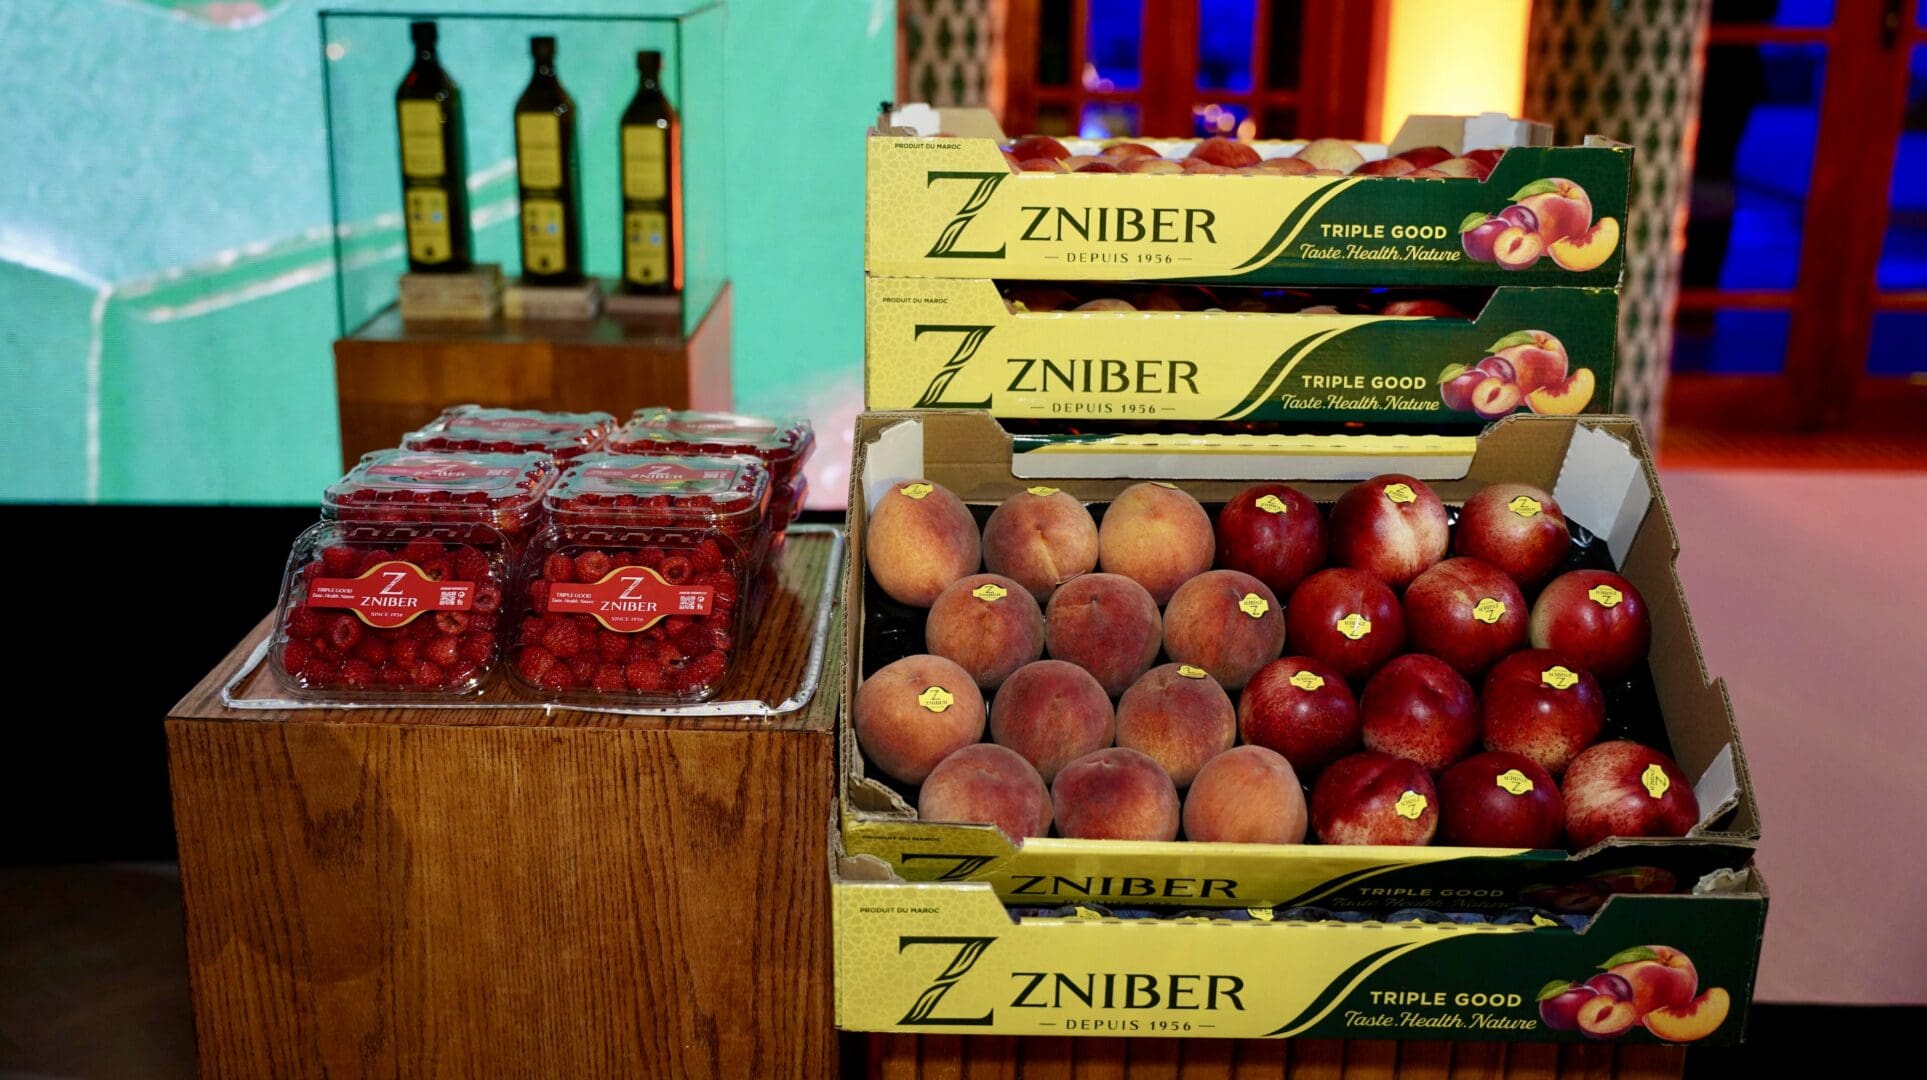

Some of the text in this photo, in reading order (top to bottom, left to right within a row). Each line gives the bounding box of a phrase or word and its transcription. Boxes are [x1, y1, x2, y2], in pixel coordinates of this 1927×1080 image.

[924, 171, 1010, 259] Z
[1019, 206, 1218, 244] ZNIBER
[1321, 224, 1448, 239] TRIPLE GOOD
[1067, 252, 1173, 264] DEPUIS 1956
[913, 324, 996, 409] Z
[1006, 358, 1200, 395] ZNIBER
[1301, 375, 1426, 389] TRIPLE GOOD
[1052, 402, 1156, 414] DEPUIS 1956
[379, 572, 407, 595] Z
[618, 577, 645, 600] Z
[360, 596, 418, 608] ZNIBER
[600, 601, 658, 612] ZNIBER
[1010, 875, 1239, 899] ZNIBER
[1359, 888, 1504, 898] TRIPLE GOOD
[896, 936, 999, 1026] Z
[1010, 972, 1246, 1010] ZNIBER
[1370, 991, 1522, 1007] TRIPLE GOOD
[1066, 1020, 1192, 1031] DEPUIS 1956
